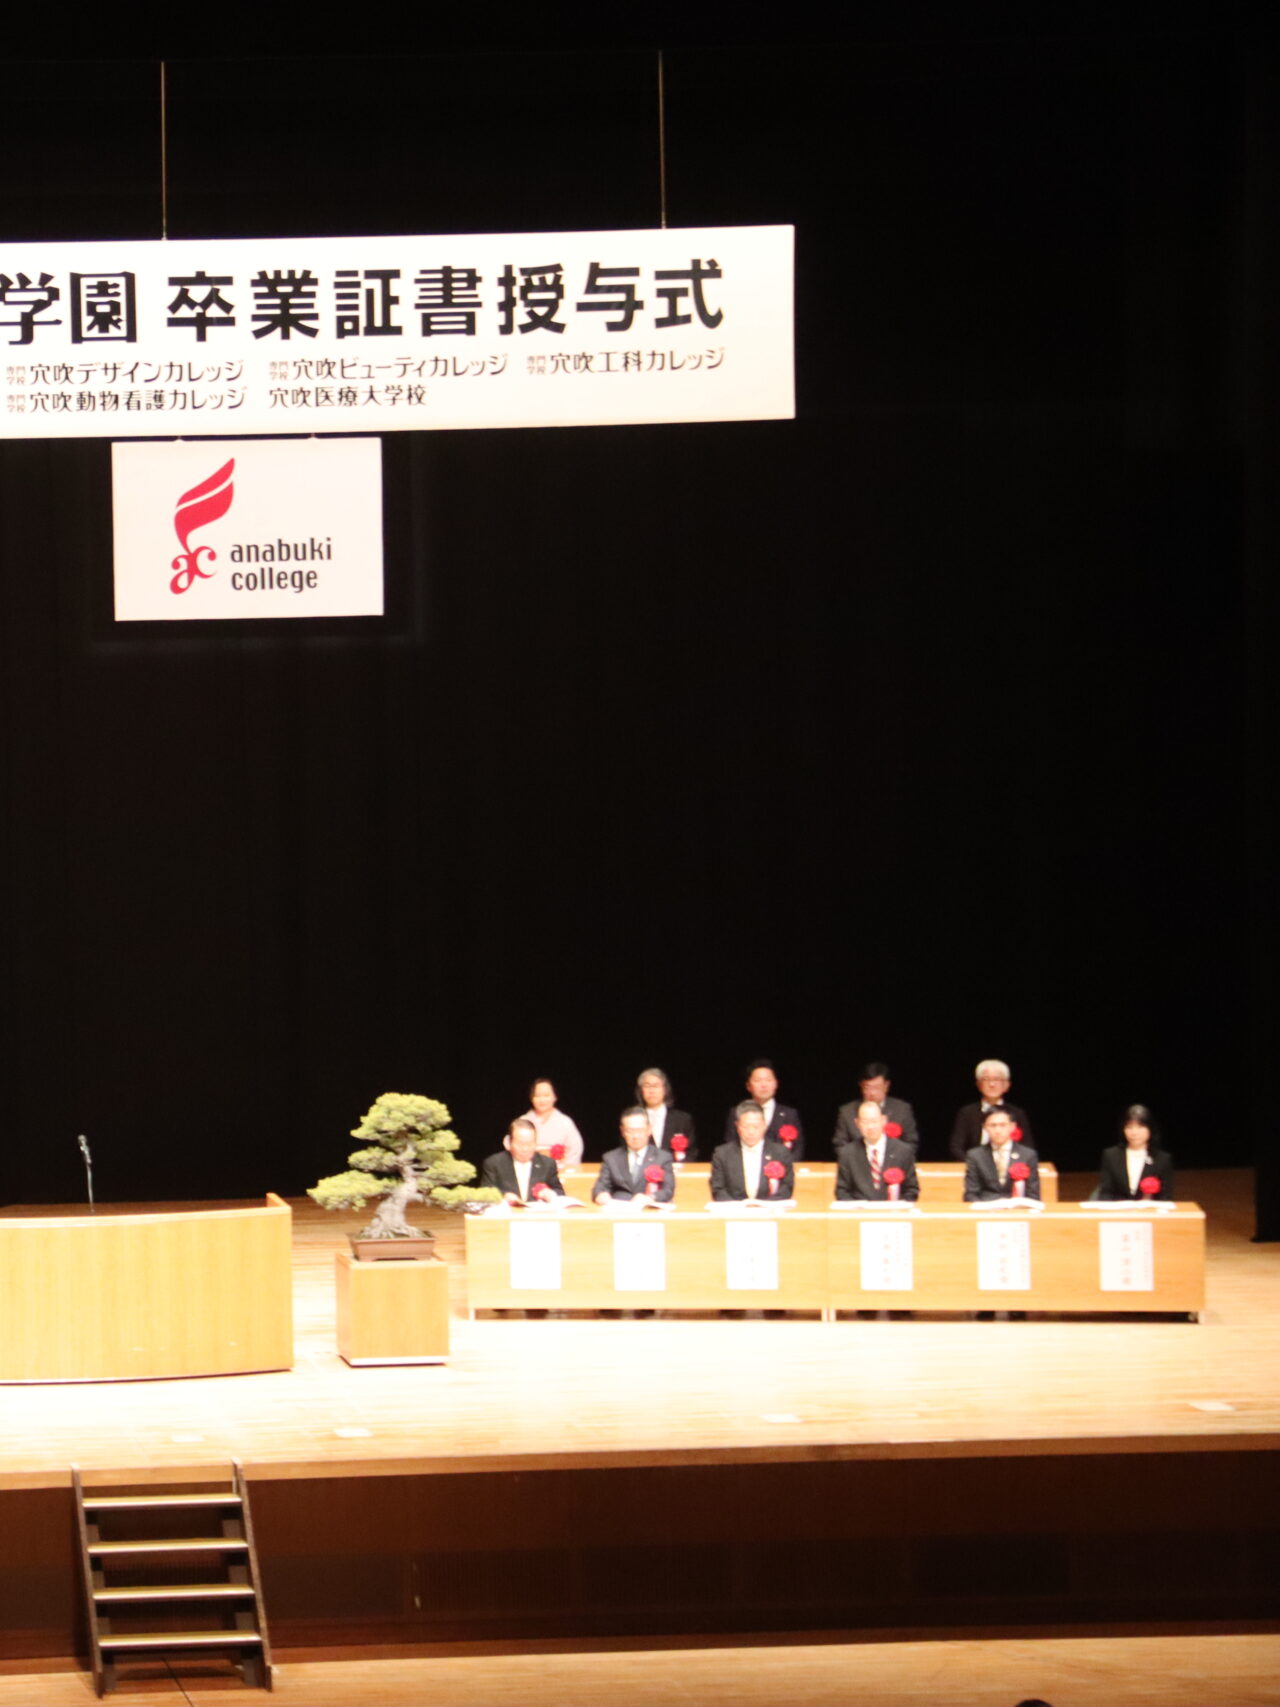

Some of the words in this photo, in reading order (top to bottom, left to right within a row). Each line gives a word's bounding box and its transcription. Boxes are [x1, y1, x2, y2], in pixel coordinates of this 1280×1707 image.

[167, 258, 724, 342] 卒業証書授与式
[30, 361, 242, 384] 穴吹デザインカレッジ
[293, 356, 506, 380] 穴吹ビューティカレッジ
[550, 350, 723, 373] 穴吹工科カレッジ
[30, 387, 246, 412] 穴吹動物看護カレッジ
[269, 384, 426, 408] 穴吹医療大学校
[230, 537, 331, 563] anabuki
[231, 567, 317, 593] college
